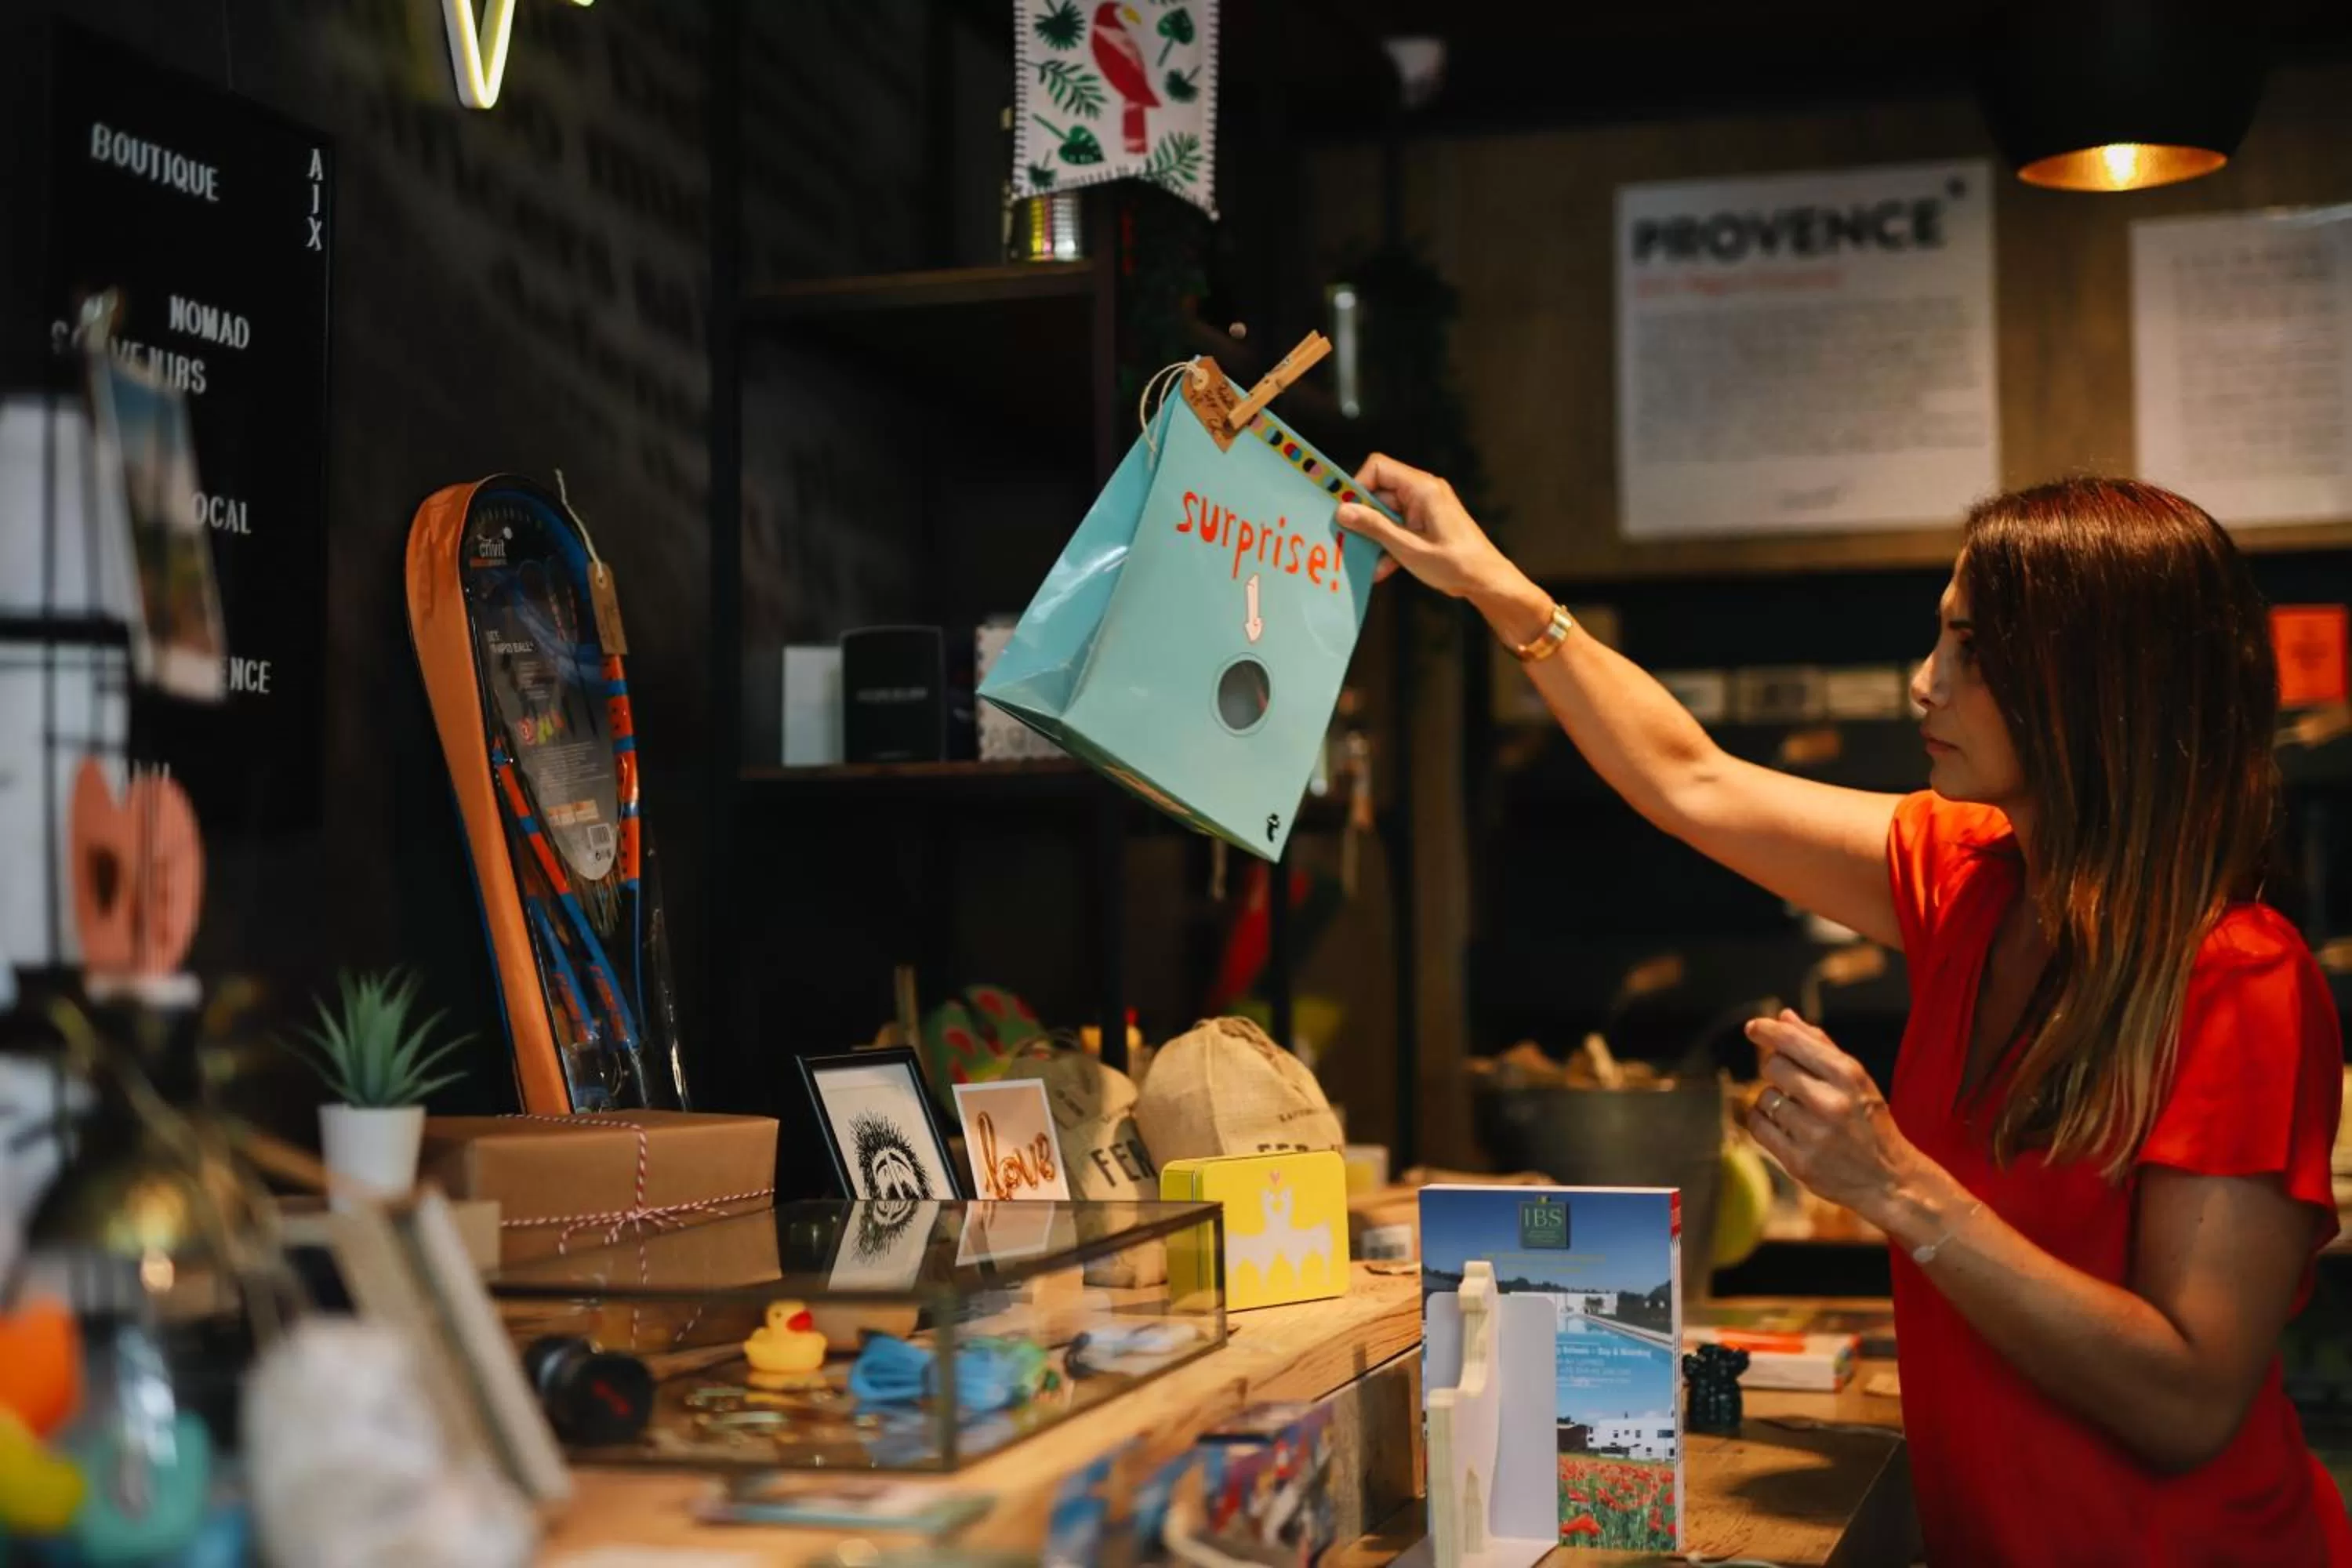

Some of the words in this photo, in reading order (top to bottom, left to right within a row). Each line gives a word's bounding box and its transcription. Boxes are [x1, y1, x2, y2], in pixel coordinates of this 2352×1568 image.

[90, 122, 220, 202] BOUTIQUE
[168, 294, 251, 350] NOMAD
[191, 491, 252, 535] OCAL
[1175, 491, 1346, 593] surprise!
[976, 1110, 1056, 1200] love
